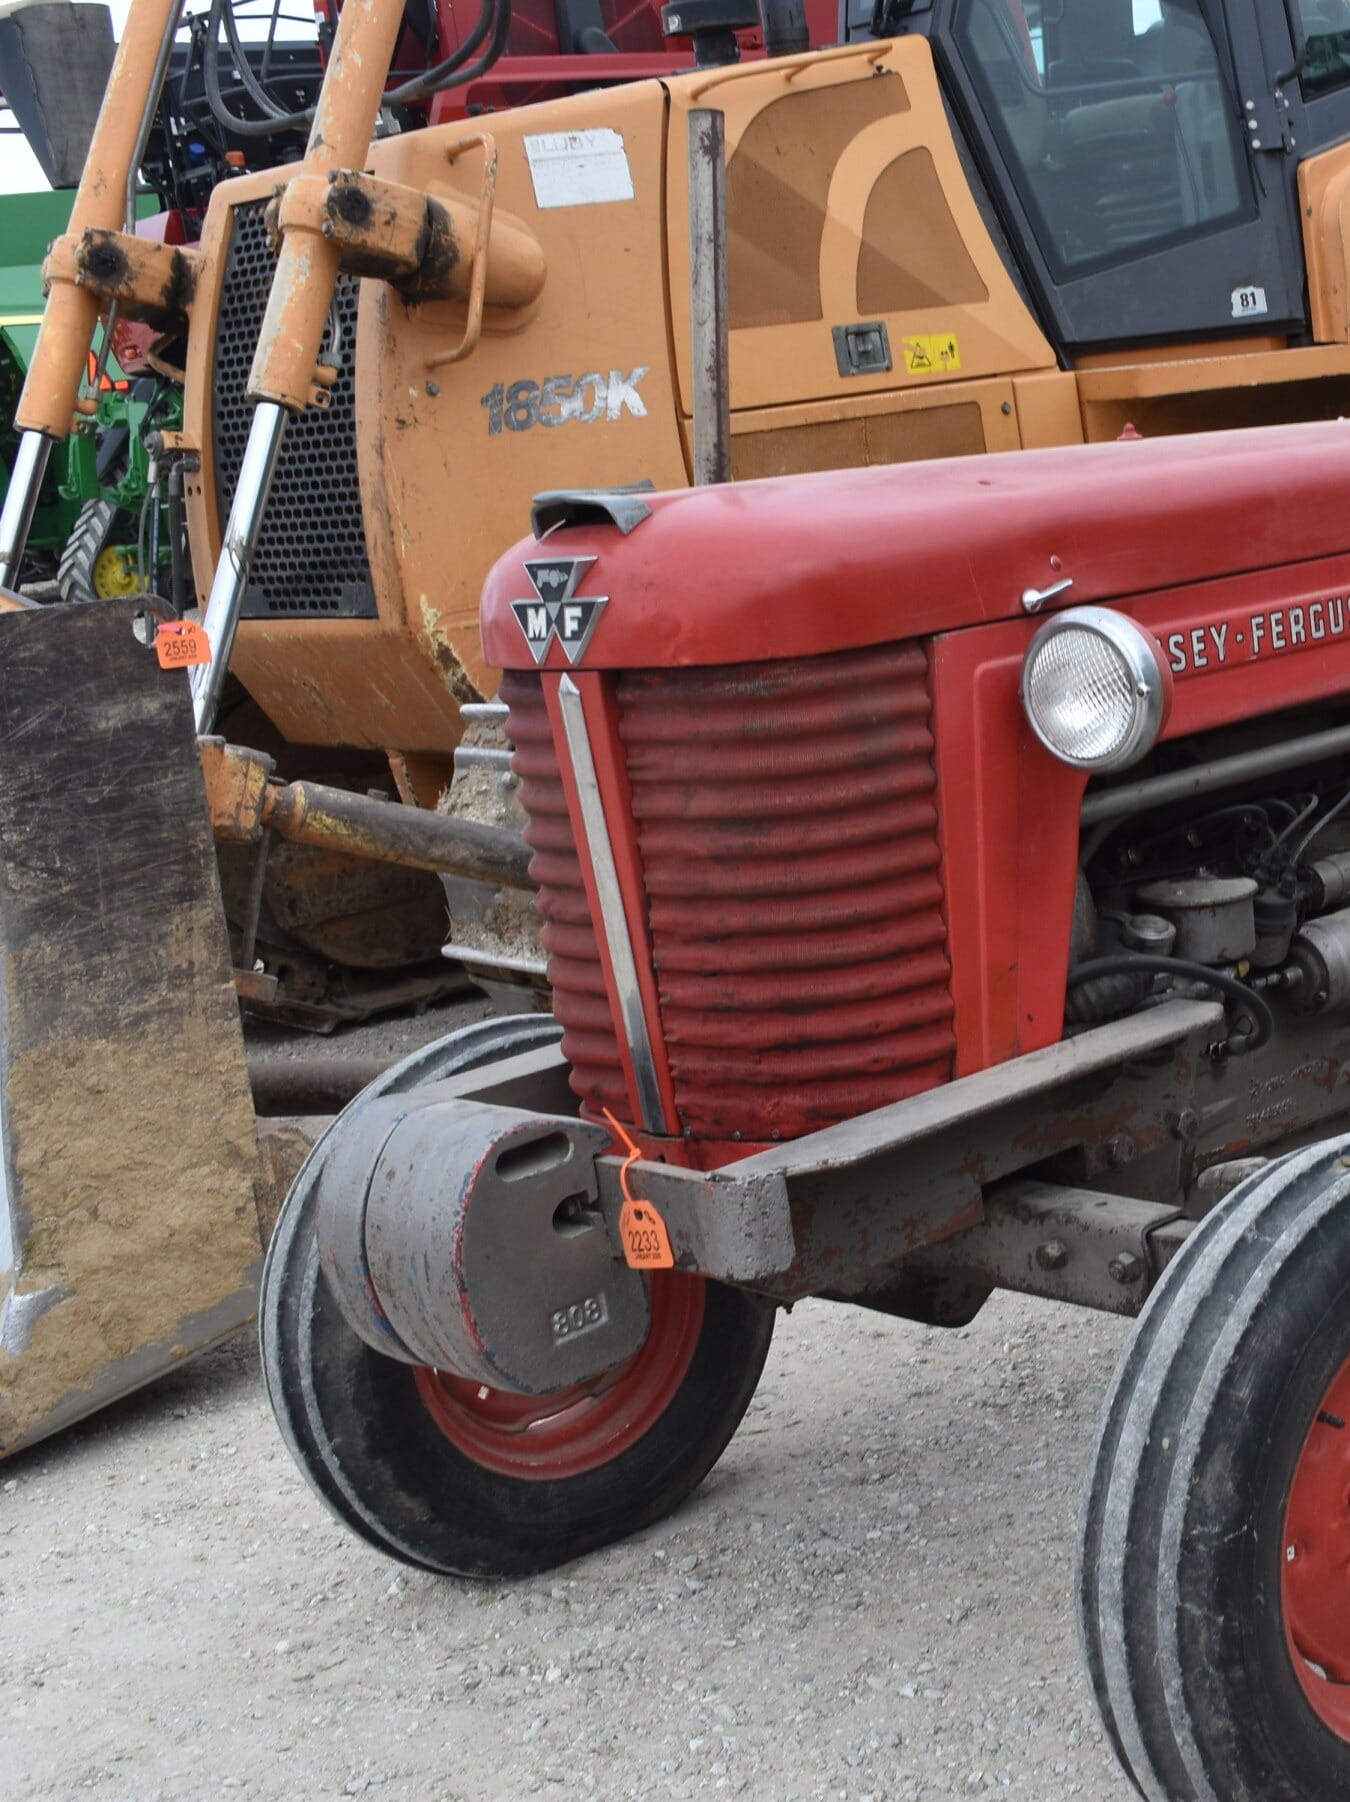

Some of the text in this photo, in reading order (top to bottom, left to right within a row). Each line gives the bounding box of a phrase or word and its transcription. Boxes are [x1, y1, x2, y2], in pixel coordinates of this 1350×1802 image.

[1240, 292, 1257, 308] 81
[480, 365, 650, 437] 1850K
[163, 638, 198, 658] 2559
[628, 1230, 660, 1253] 2233
